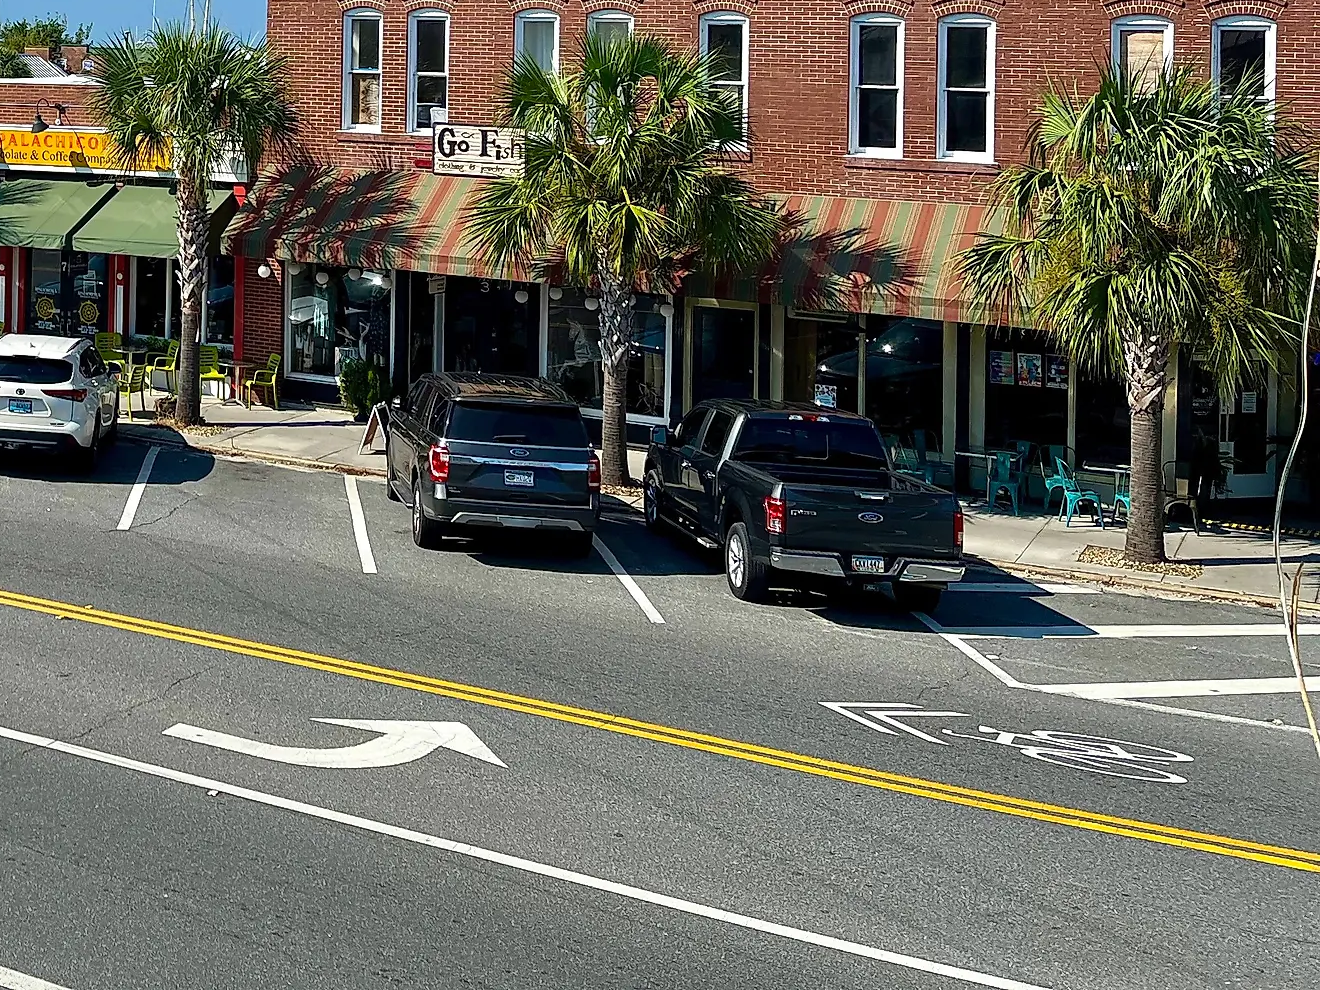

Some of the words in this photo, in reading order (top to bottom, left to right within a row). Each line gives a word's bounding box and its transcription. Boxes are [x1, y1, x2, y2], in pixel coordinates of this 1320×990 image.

[438, 127, 470, 158] Go
[478, 128, 522, 160] Fish
[30, 150, 39, 161] &
[42, 150, 74, 163] Coffee
